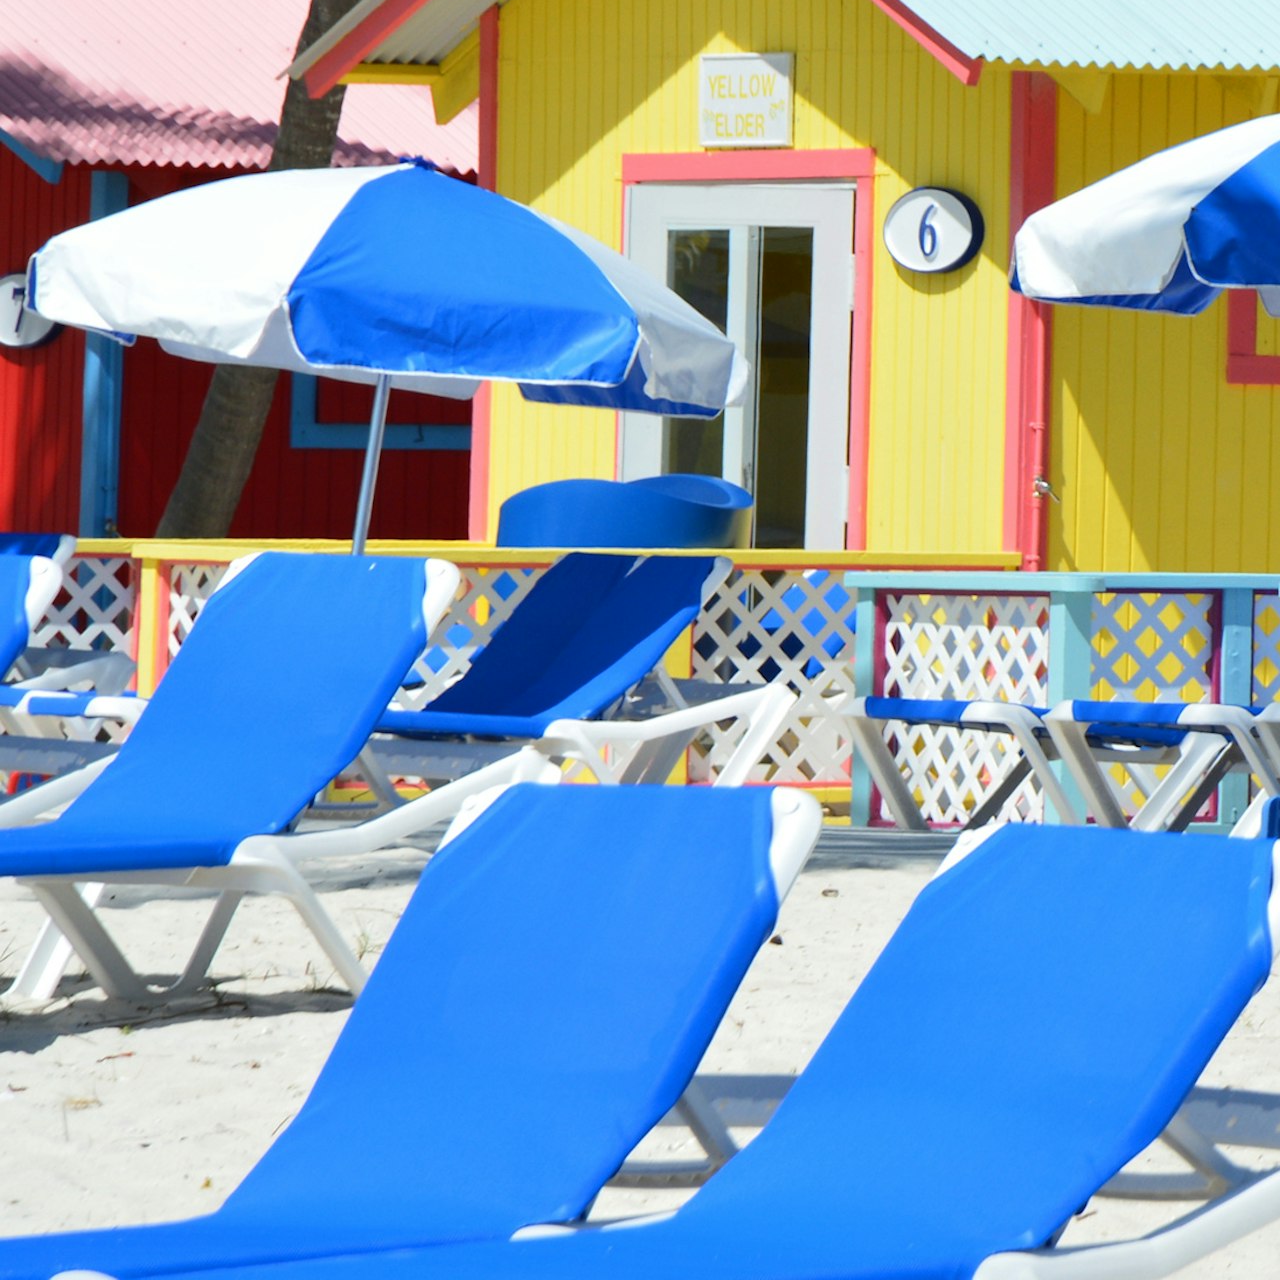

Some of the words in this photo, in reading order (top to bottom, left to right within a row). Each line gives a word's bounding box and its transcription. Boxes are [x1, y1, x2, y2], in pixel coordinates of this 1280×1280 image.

[707, 74, 777, 99] YELLOW
[715, 112, 765, 137] ELDER
[919, 204, 937, 257] 6
